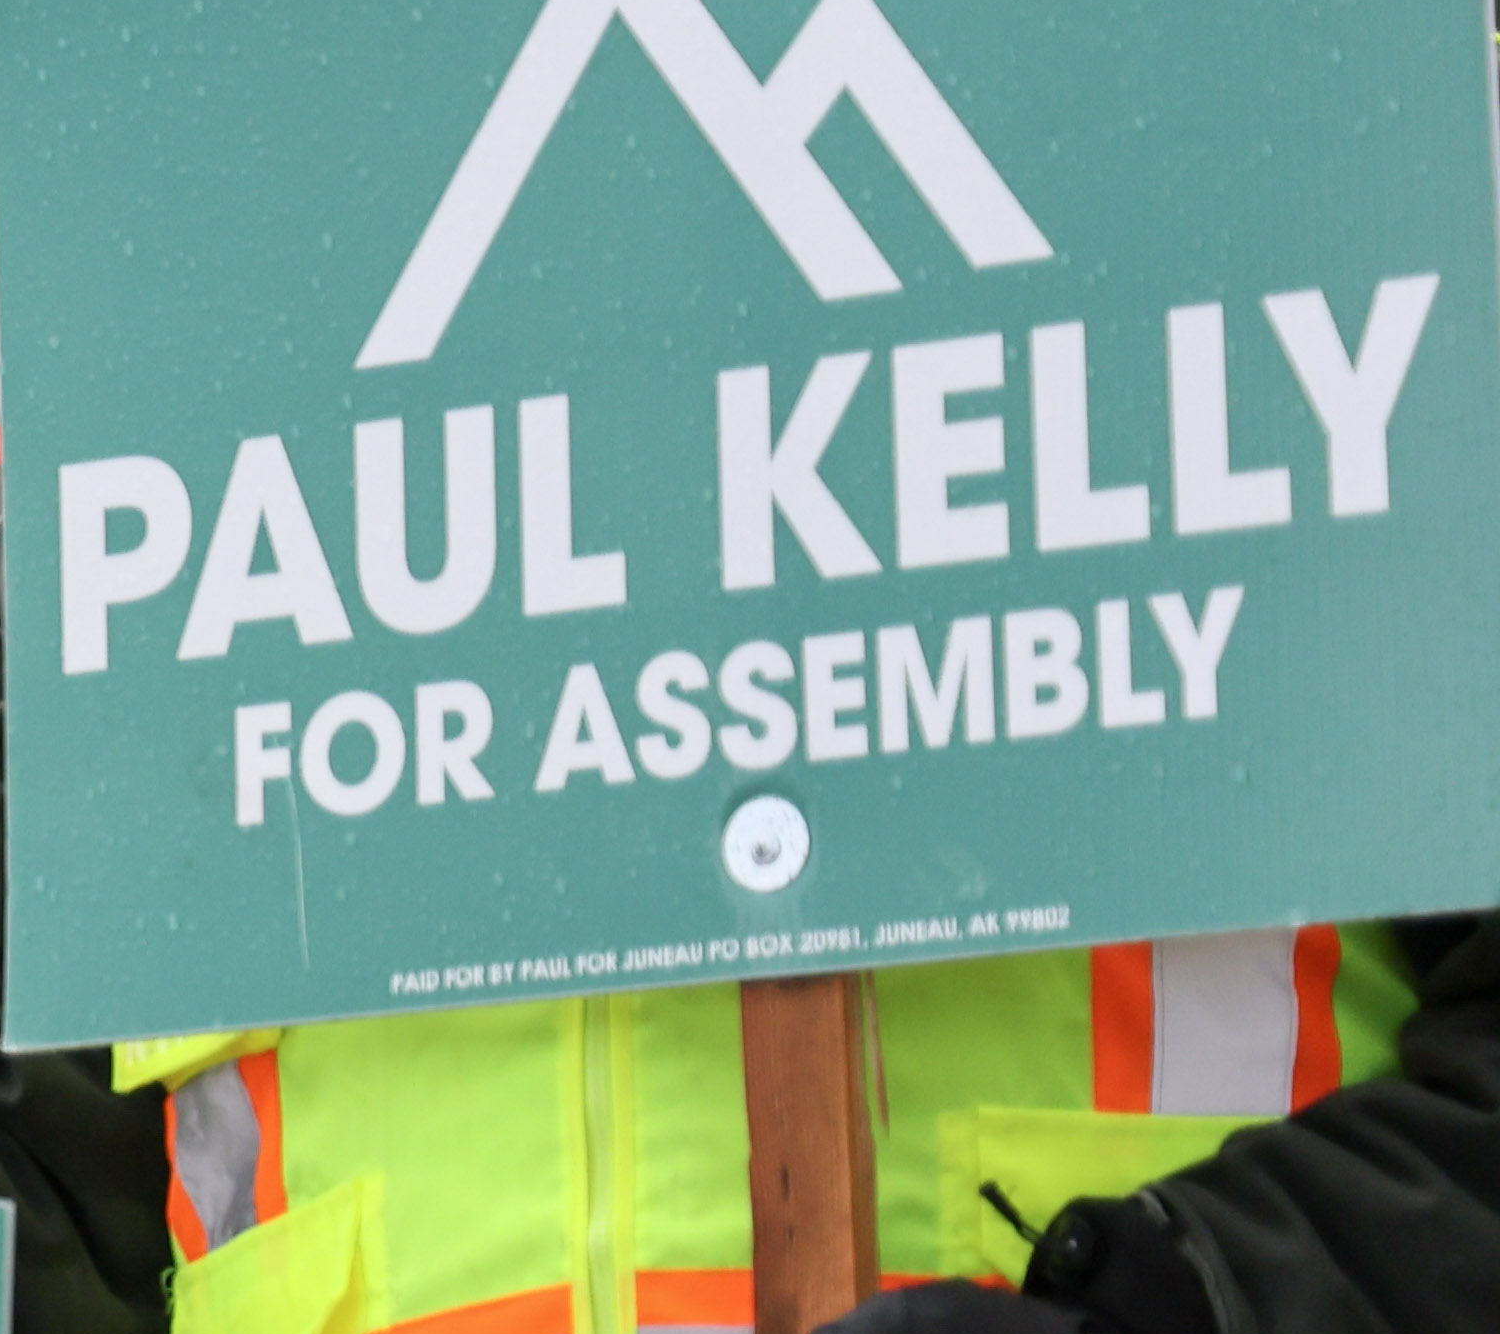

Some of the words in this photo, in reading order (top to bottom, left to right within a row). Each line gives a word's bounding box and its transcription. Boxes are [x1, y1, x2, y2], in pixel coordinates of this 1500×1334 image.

[60, 395, 626, 675] PAUL
[718, 274, 1439, 590] KELLY
[236, 681, 494, 827] FOR
[536, 587, 1243, 791] ASSEMBLY
[390, 970, 440, 995] PAID
[443, 965, 485, 989] FOR
[488, 962, 514, 986] BY
[519, 957, 572, 982] PAUL
[574, 951, 617, 976] FOR
[622, 942, 703, 972] JUNEAU
[707, 938, 741, 962] PO
[743, 933, 794, 960] BOX
[874, 917, 963, 948] JUNEAU,
[967, 912, 1000, 937] AK
